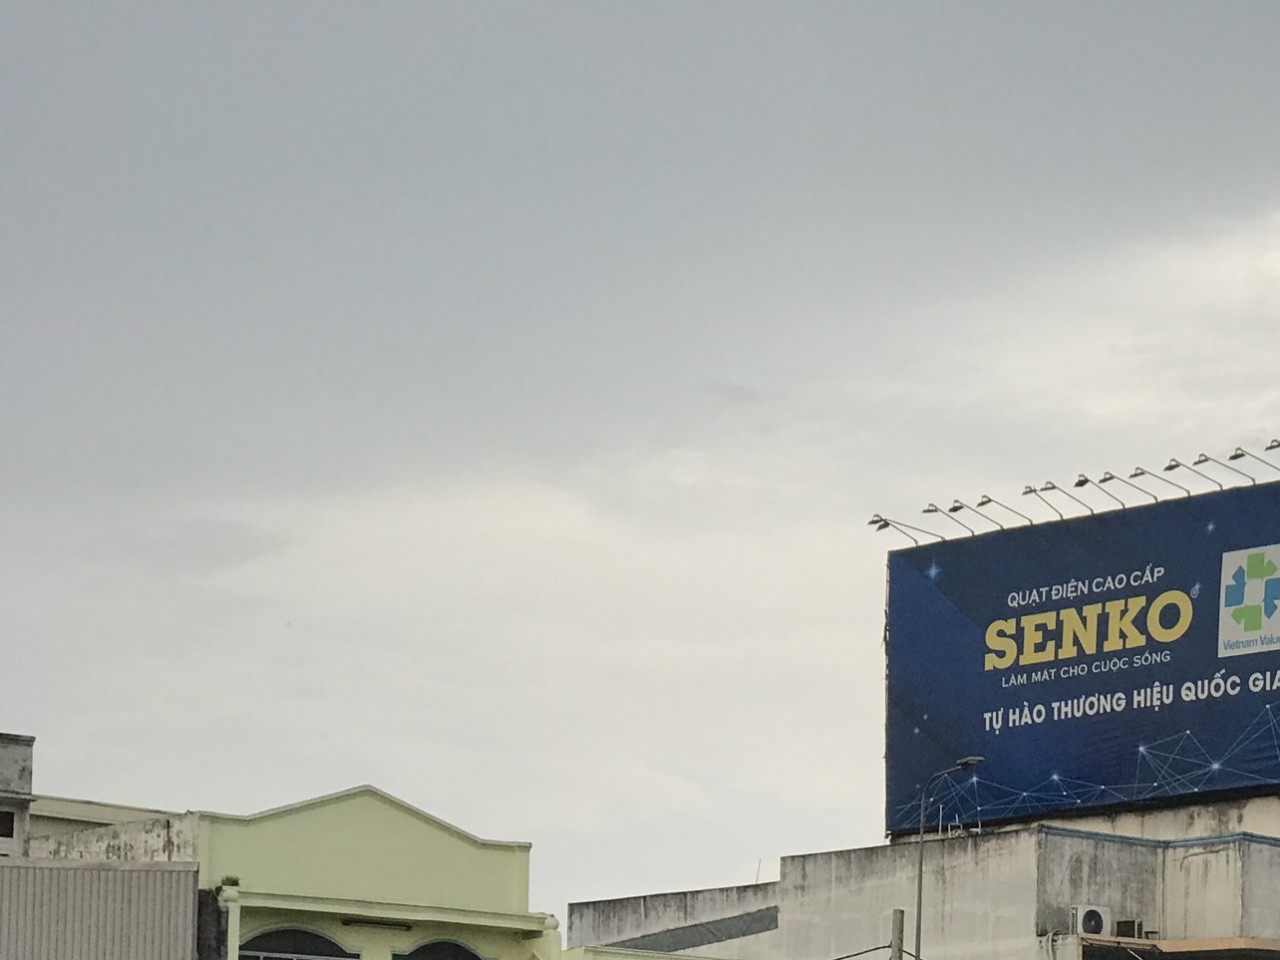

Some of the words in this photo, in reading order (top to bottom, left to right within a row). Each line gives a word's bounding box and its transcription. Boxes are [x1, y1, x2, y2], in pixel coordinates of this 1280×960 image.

[1007, 587, 1050, 607] QUẠT
[1051, 579, 1089, 601] ĐIỆN
[1092, 573, 1126, 591] CAO
[1129, 563, 1165, 586] CẤP
[984, 590, 1193, 671] SENKO
[1223, 637, 1258, 651] Vietnam
[1002, 673, 1027, 688] LÀM
[1061, 663, 1088, 678] CHO
[1092, 656, 1129, 674] CUỘC
[1133, 650, 1171, 667] SỐNG
[984, 708, 1005, 734] TỰ
[1009, 702, 1046, 728] HÀO
[1052, 692, 1126, 721] THƯƠNG
[1133, 681, 1174, 711] HIỆU
[1180, 669, 1241, 702] QUỐC
